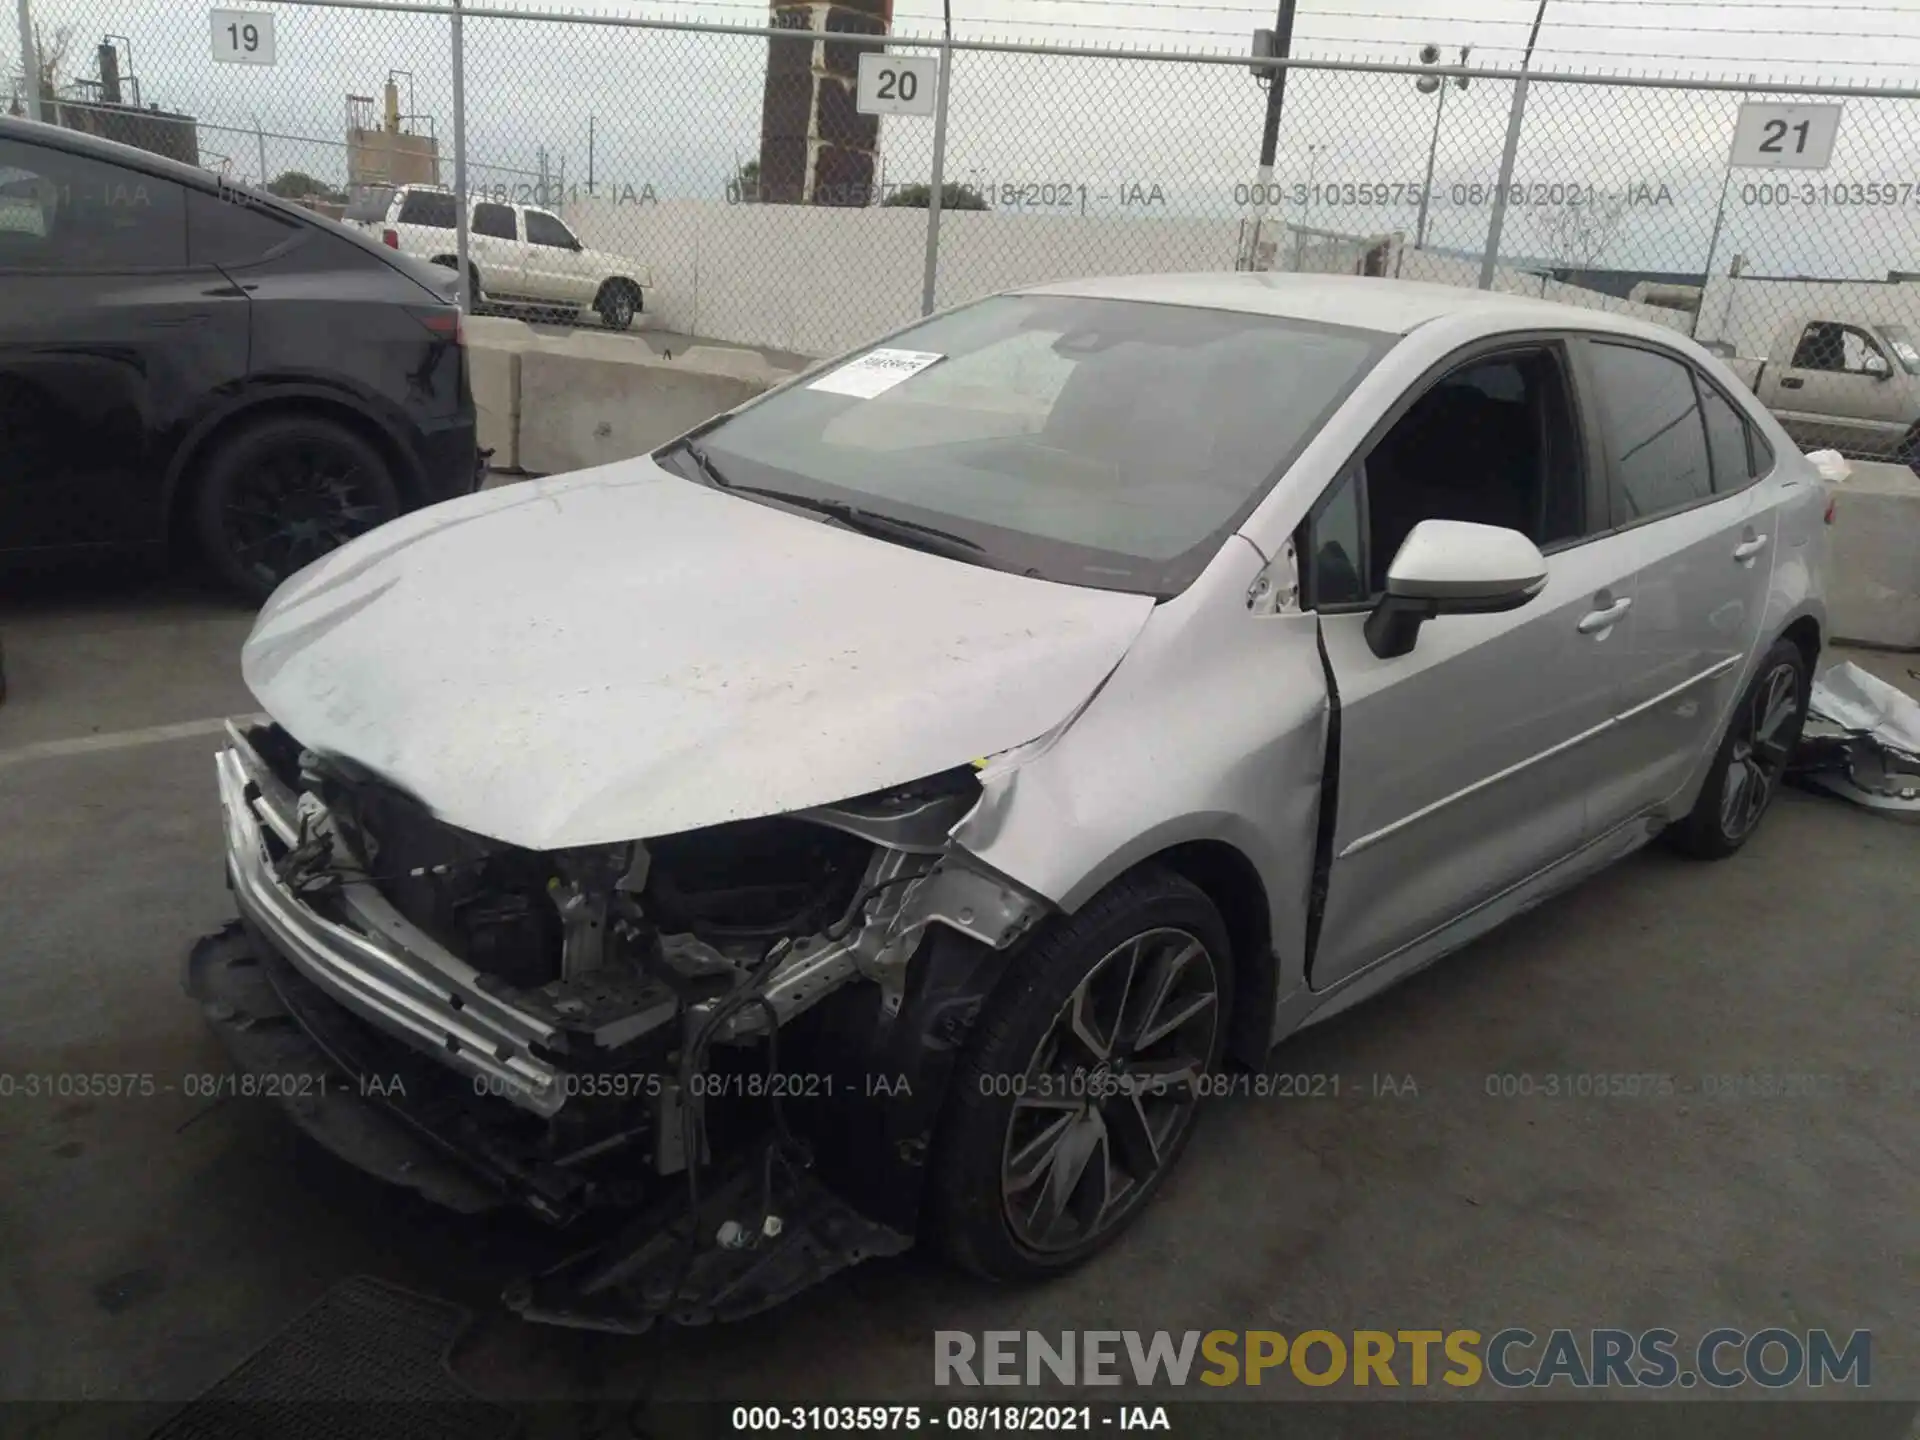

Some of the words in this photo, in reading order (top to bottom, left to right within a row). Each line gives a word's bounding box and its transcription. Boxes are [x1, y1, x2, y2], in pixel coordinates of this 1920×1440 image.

[227, 22, 258, 52] 19
[877, 69, 917, 101] 20
[1758, 119, 1810, 153] 21
